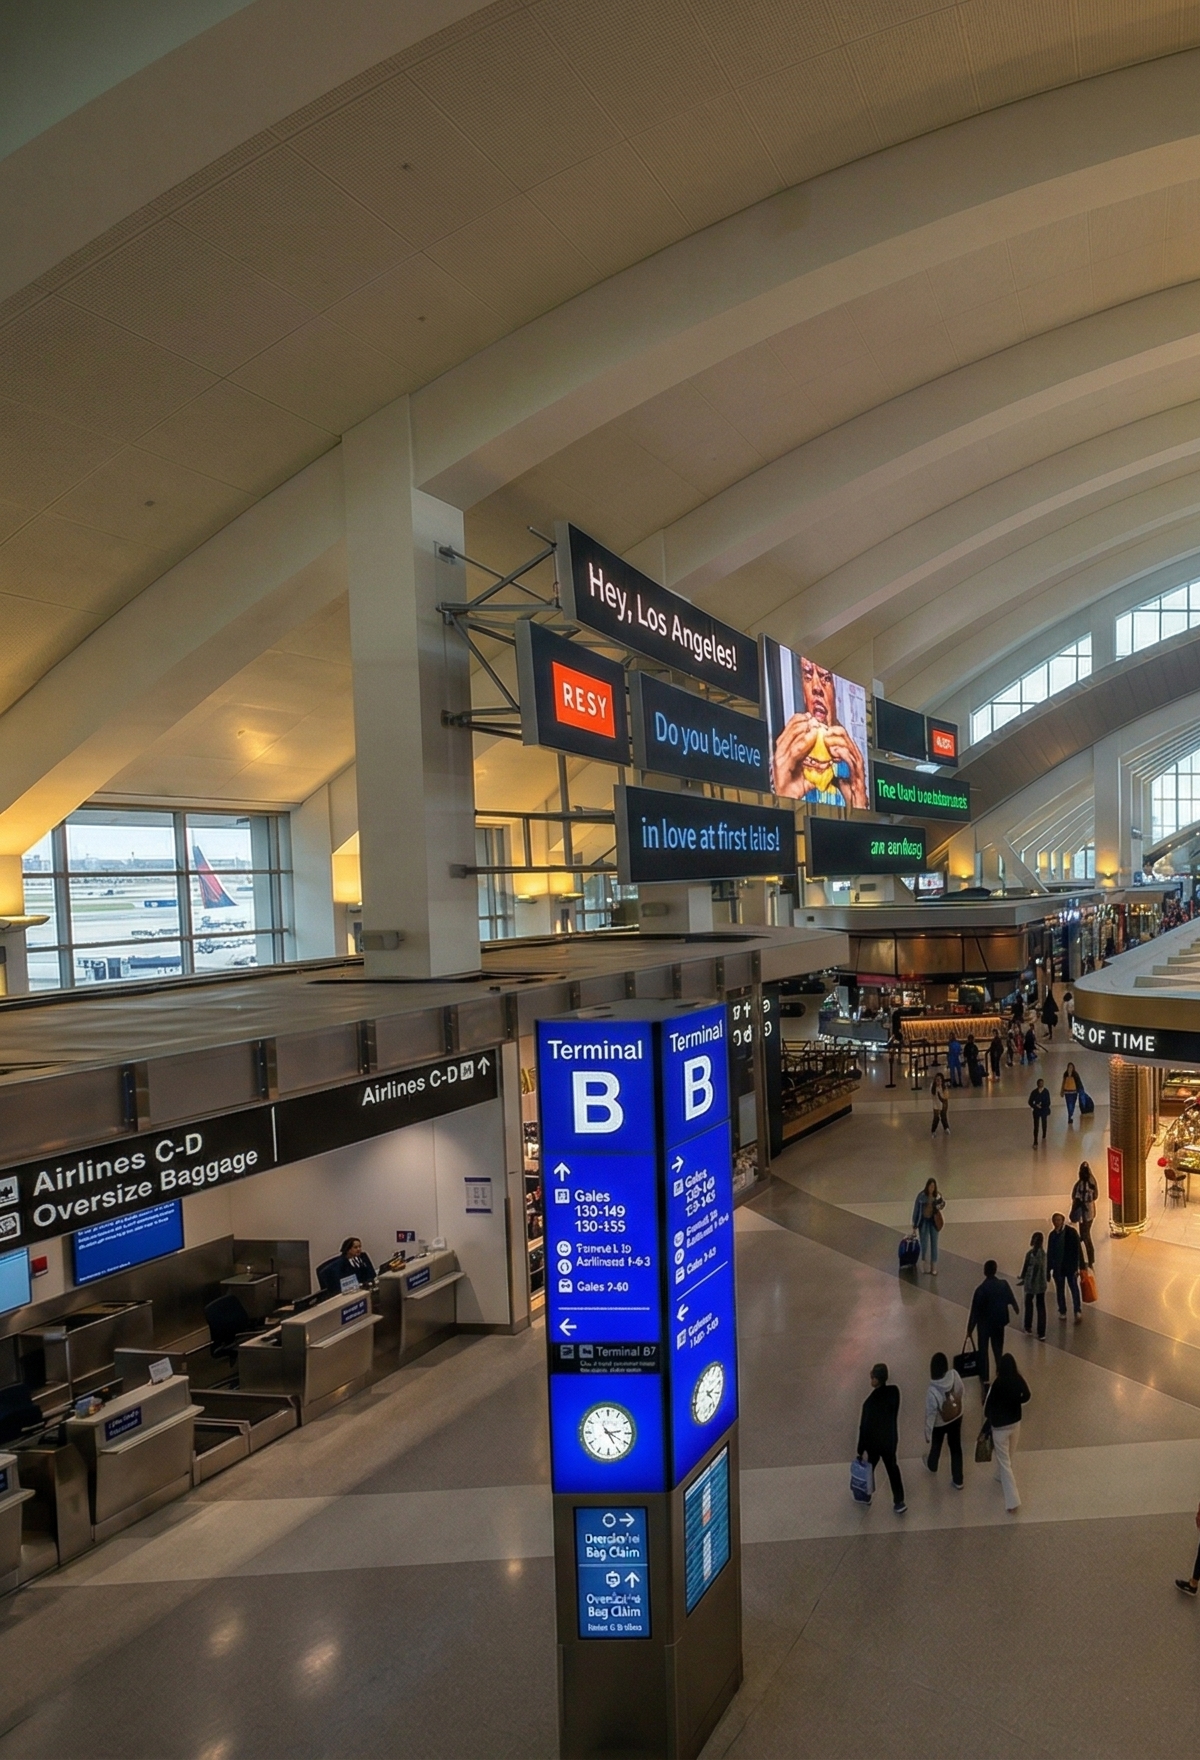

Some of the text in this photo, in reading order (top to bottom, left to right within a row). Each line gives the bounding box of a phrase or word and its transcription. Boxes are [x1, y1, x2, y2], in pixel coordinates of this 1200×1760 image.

[588, 562, 738, 672] Hey, Los Angeles!
[562, 681, 608, 719] RESY
[654, 711, 761, 767] Do you believe
[641, 816, 660, 849] in
[662, 818, 697, 850] love
[700, 825, 716, 850] at
[717, 821, 747, 851] first
[547, 1040, 643, 1060] Terminal
[669, 1019, 723, 1053] Terminal
[1088, 1027, 1106, 1045] OF
[1111, 1031, 1155, 1052] TIME
[361, 1065, 459, 1106] Airlines C-D
[572, 1070, 624, 1134] B
[684, 1055, 714, 1121] B
[33, 1132, 204, 1197] Airlines C-D
[33, 1180, 153, 1227] Oversize
[160, 1150, 259, 1192] Baggage
[574, 1204, 626, 1217] 130-149
[596, 1346, 640, 1357] Terminal
